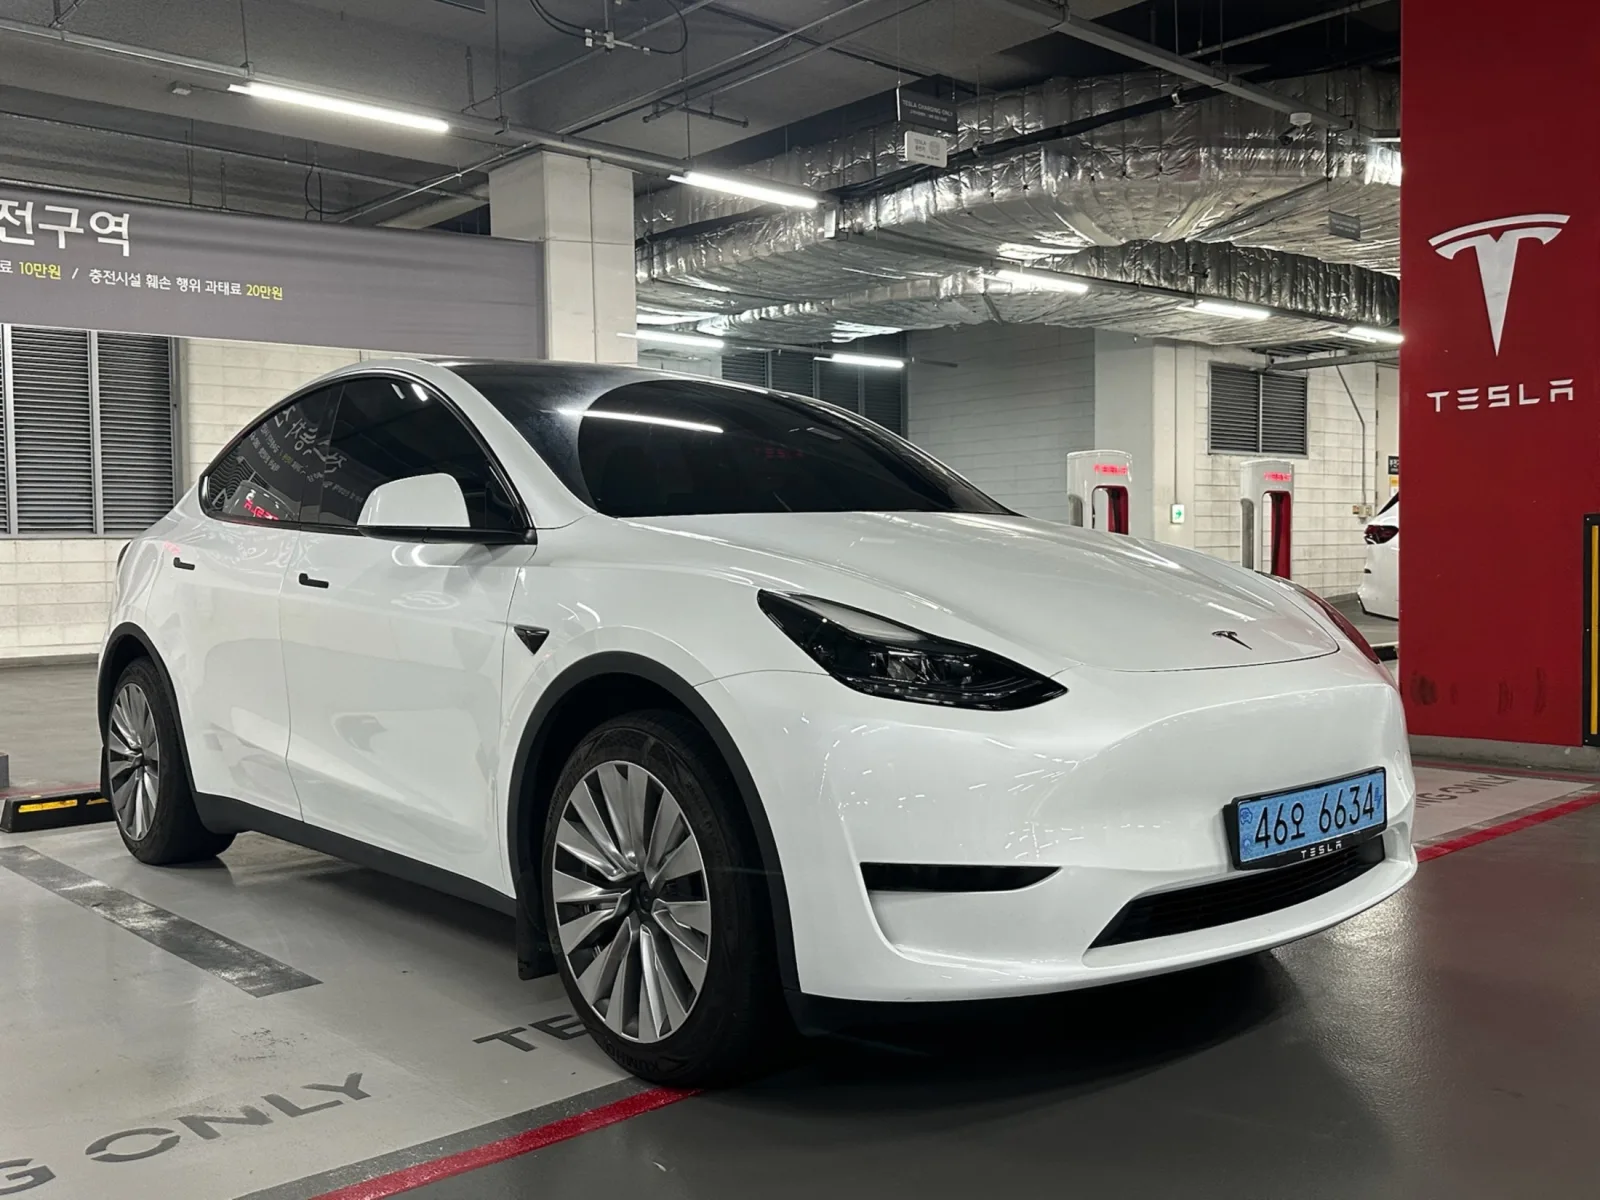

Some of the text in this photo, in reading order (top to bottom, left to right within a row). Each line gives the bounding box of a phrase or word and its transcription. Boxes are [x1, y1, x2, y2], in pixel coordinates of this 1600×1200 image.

[0, 199, 130, 257] 전구역
[19, 261, 61, 280] 10만원
[71, 267, 79, 280] /
[89, 268, 141, 288] 충전시설
[146, 273, 171, 291] 훼손
[176, 277, 200, 293] 행위
[205, 280, 242, 296] 과태료
[246, 284, 283, 301] 20만원
[1426, 378, 1574, 412] TESLA
[1255, 780, 1374, 848] 46오 6634
[1300, 840, 1342, 859] TESLA
[472, 1014, 588, 1052] TE
[85, 1072, 371, 1162] ONLY
